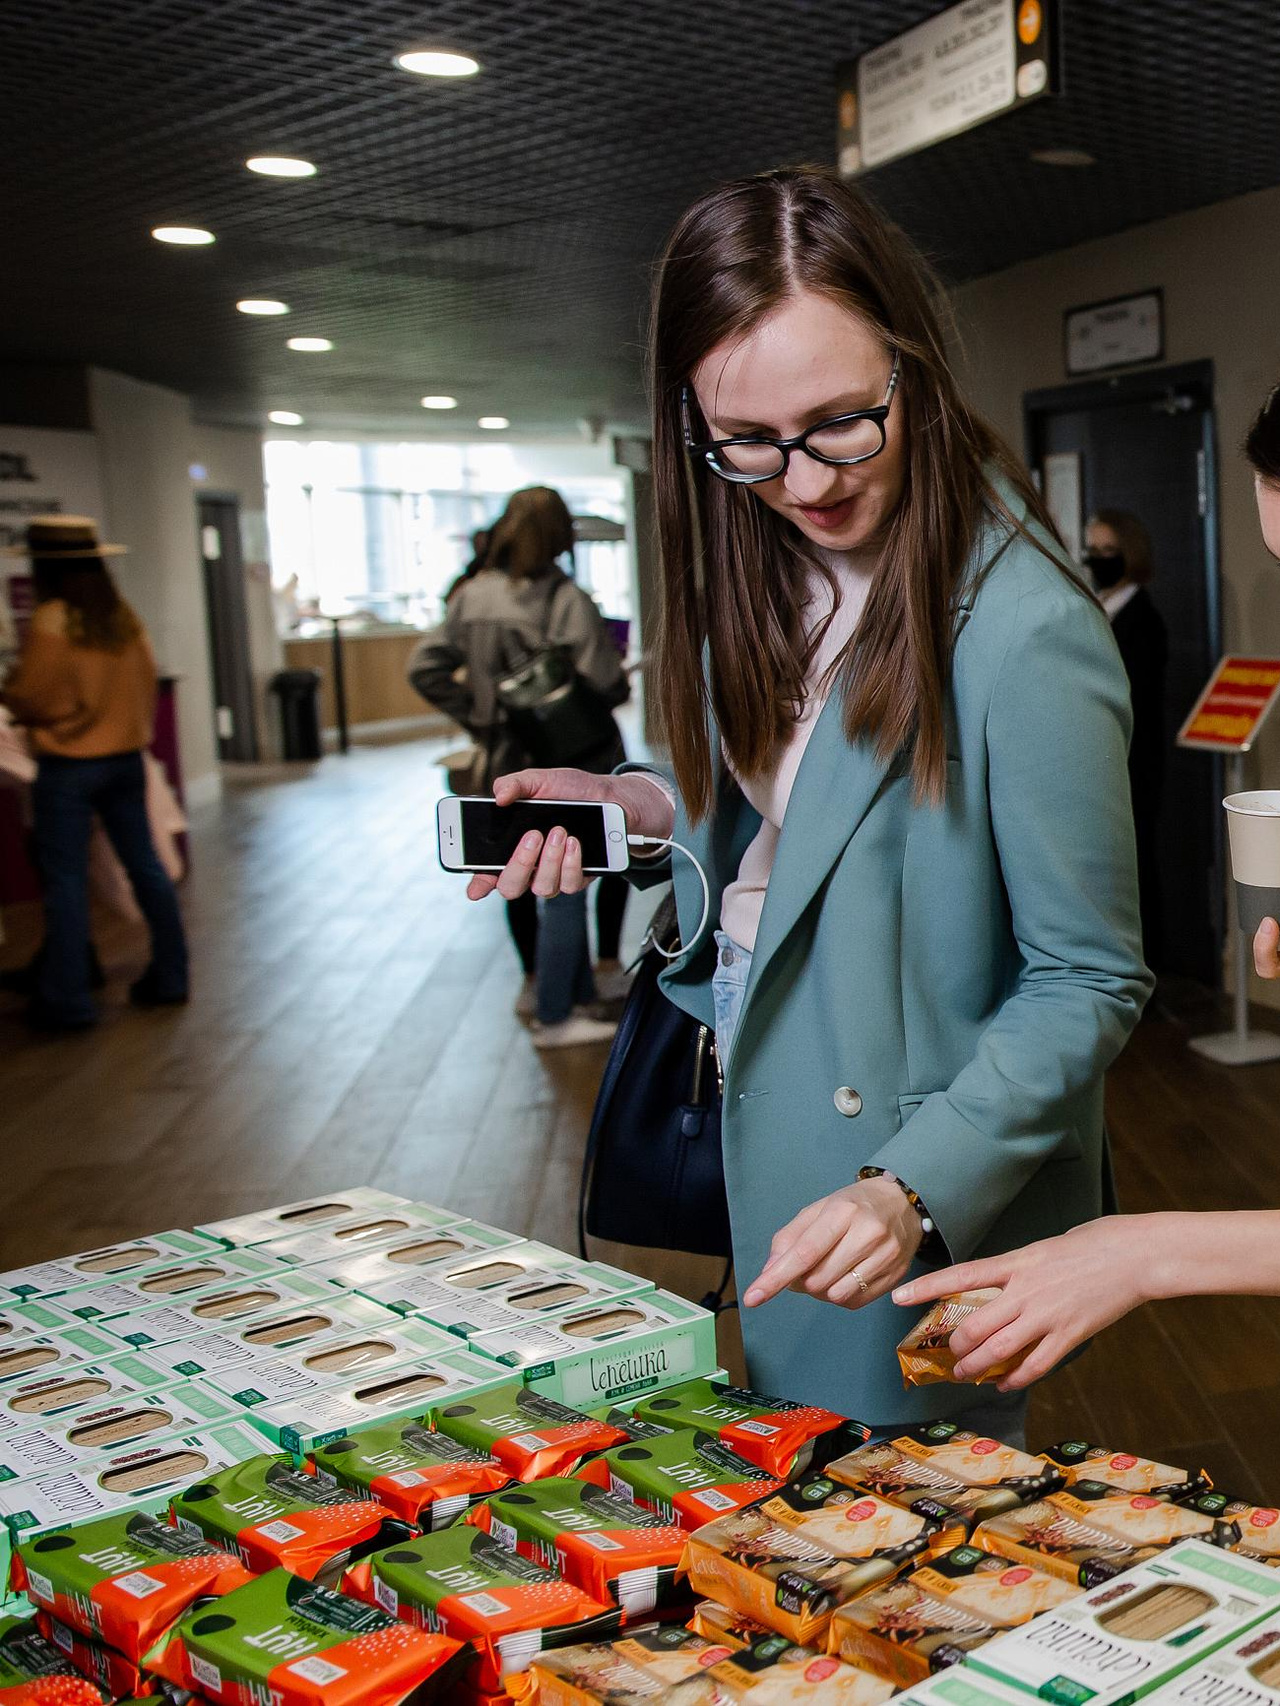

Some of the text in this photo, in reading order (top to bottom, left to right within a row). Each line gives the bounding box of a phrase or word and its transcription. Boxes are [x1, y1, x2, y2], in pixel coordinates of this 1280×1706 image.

[480, 1414, 535, 1435] НУТ
[692, 1404, 750, 1422] НУТ
[361, 1449, 418, 1473] НУТ
[657, 1461, 716, 1489] НУТ
[223, 1494, 286, 1523] НУТ
[541, 1508, 603, 1531] НУТ
[656, 1499, 683, 1528] НУТ
[79, 1546, 146, 1575] НУТ
[540, 1538, 567, 1575] НУТ
[425, 1564, 490, 1593] НУТ
[421, 1604, 448, 1636] НУТ
[242, 1625, 319, 1659] НУТ
